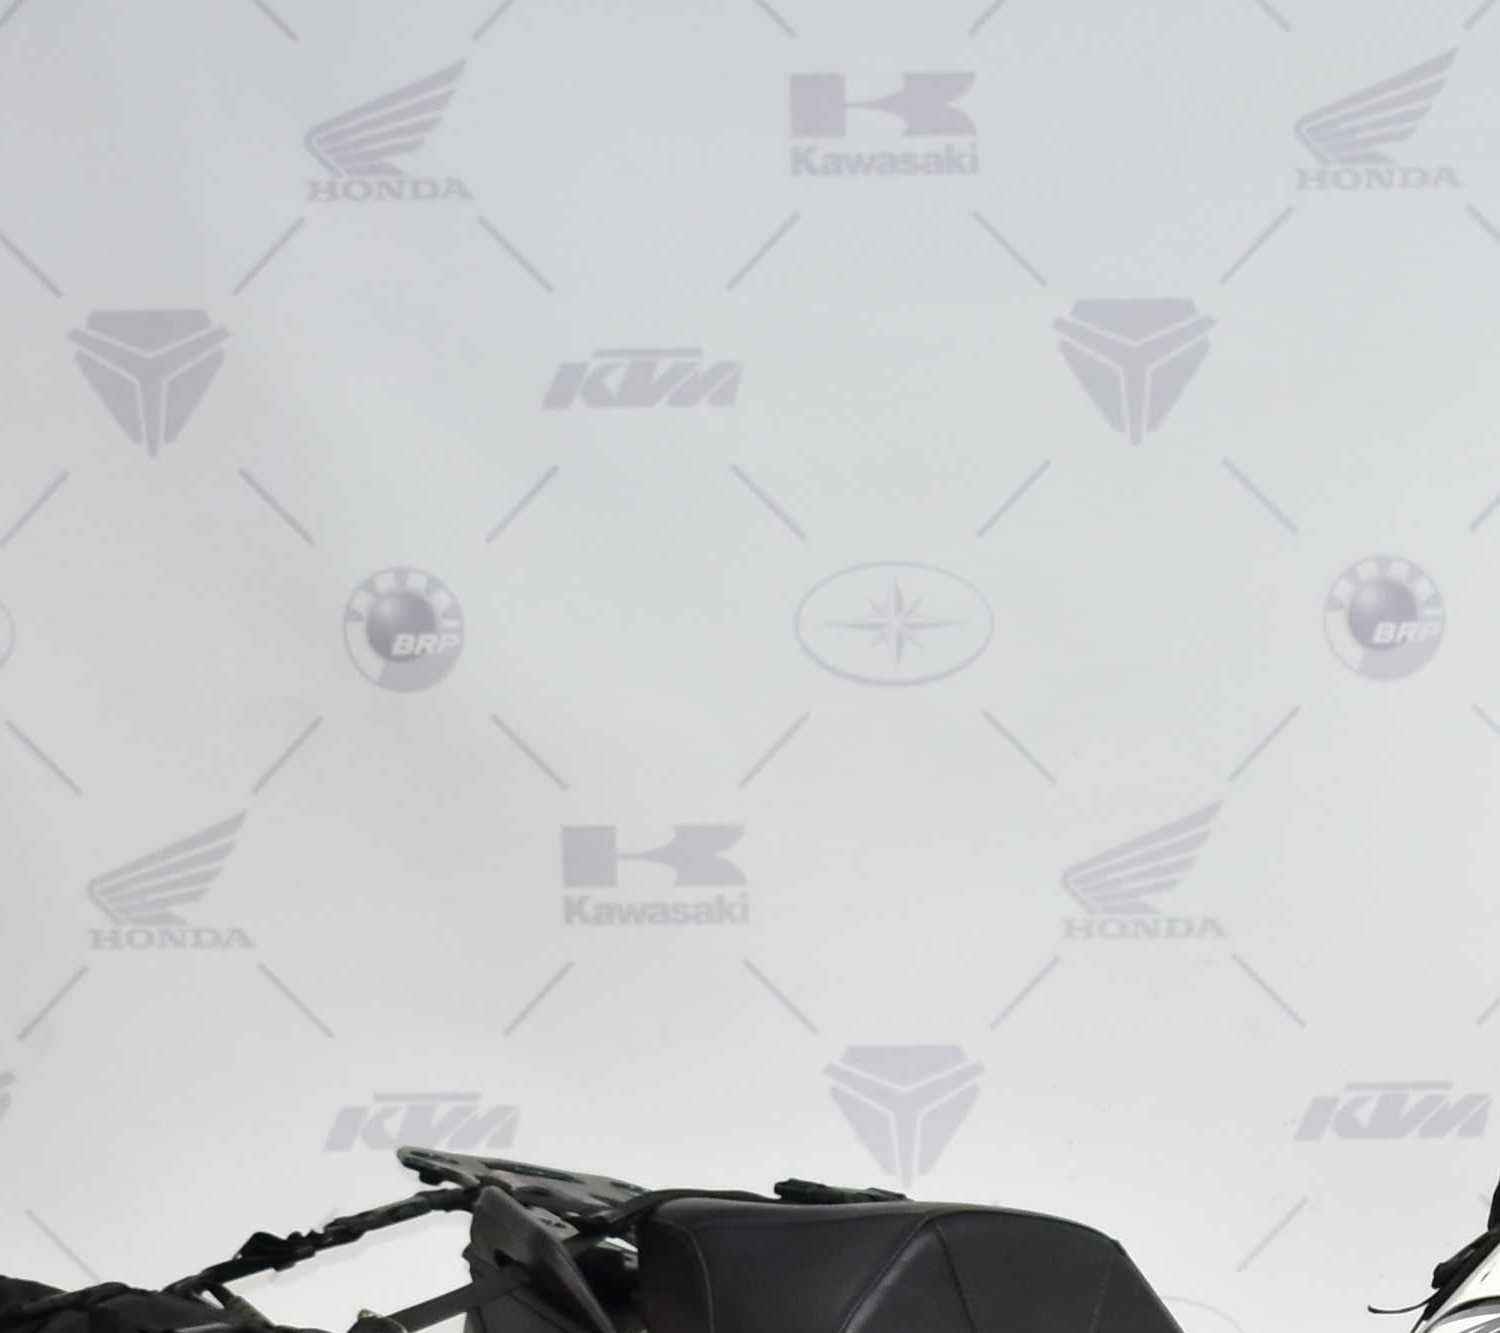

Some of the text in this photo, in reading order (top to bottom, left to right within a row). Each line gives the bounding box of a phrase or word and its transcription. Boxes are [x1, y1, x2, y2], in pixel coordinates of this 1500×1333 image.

[791, 144, 979, 176] Kawasaki
[307, 178, 471, 200] HONDA
[1295, 167, 1461, 189] HONDA
[542, 349, 741, 410] KTM
[392, 633, 460, 656] BRP
[1372, 622, 1441, 645] BRP
[562, 895, 747, 926] Kawasaki
[89, 928, 253, 949] HONDA
[1064, 917, 1227, 939] HONDA
[323, 1092, 519, 1150] KTM
[1295, 1081, 1491, 1141] KTM
